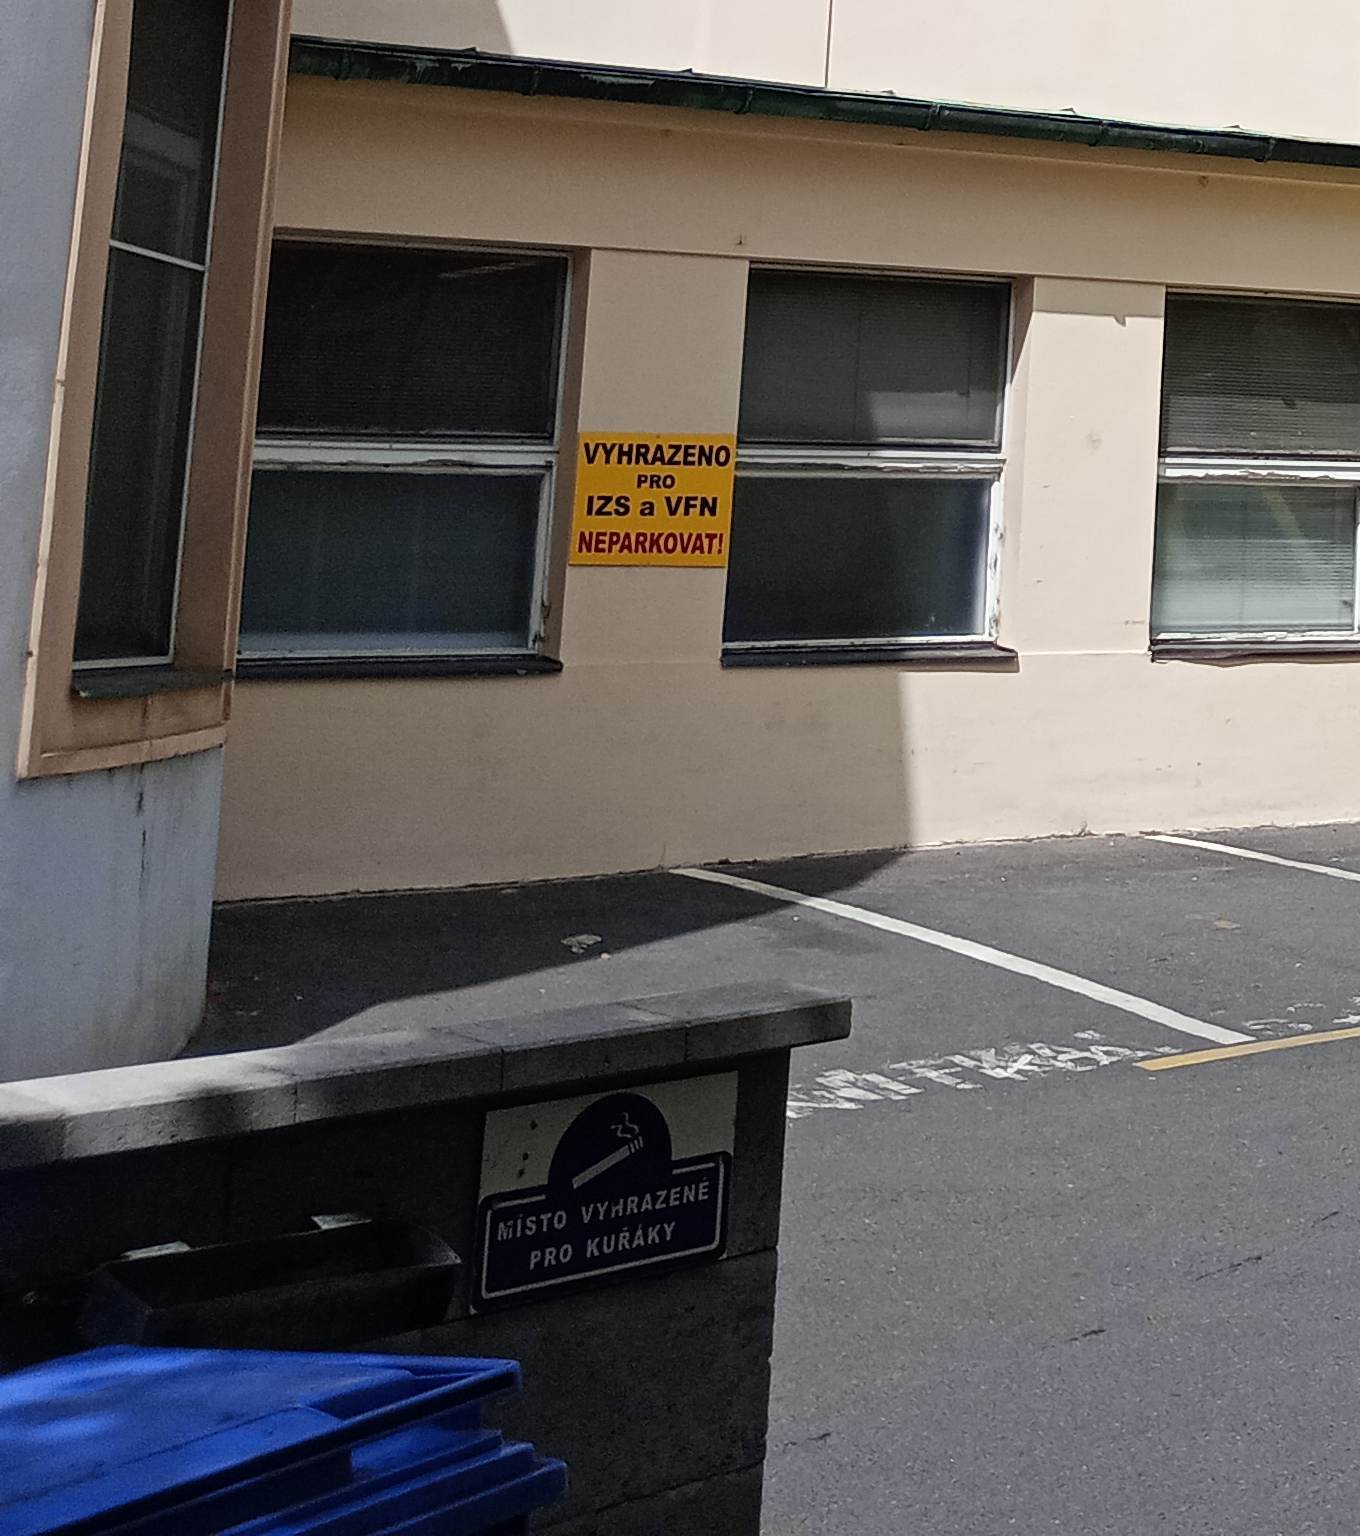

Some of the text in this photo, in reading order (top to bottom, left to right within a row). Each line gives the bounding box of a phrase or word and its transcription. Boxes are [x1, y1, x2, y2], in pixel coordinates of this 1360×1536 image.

[584, 442, 731, 467] VYHRAZENO
[636, 474, 676, 489] PRO
[586, 495, 718, 517] IZS a VFN
[578, 531, 724, 554] NEPARKOVAT!
[497, 1177, 710, 1242] MÍSTO VYHRAZENÉ
[529, 1221, 676, 1271] PRO KUŘÁKY
